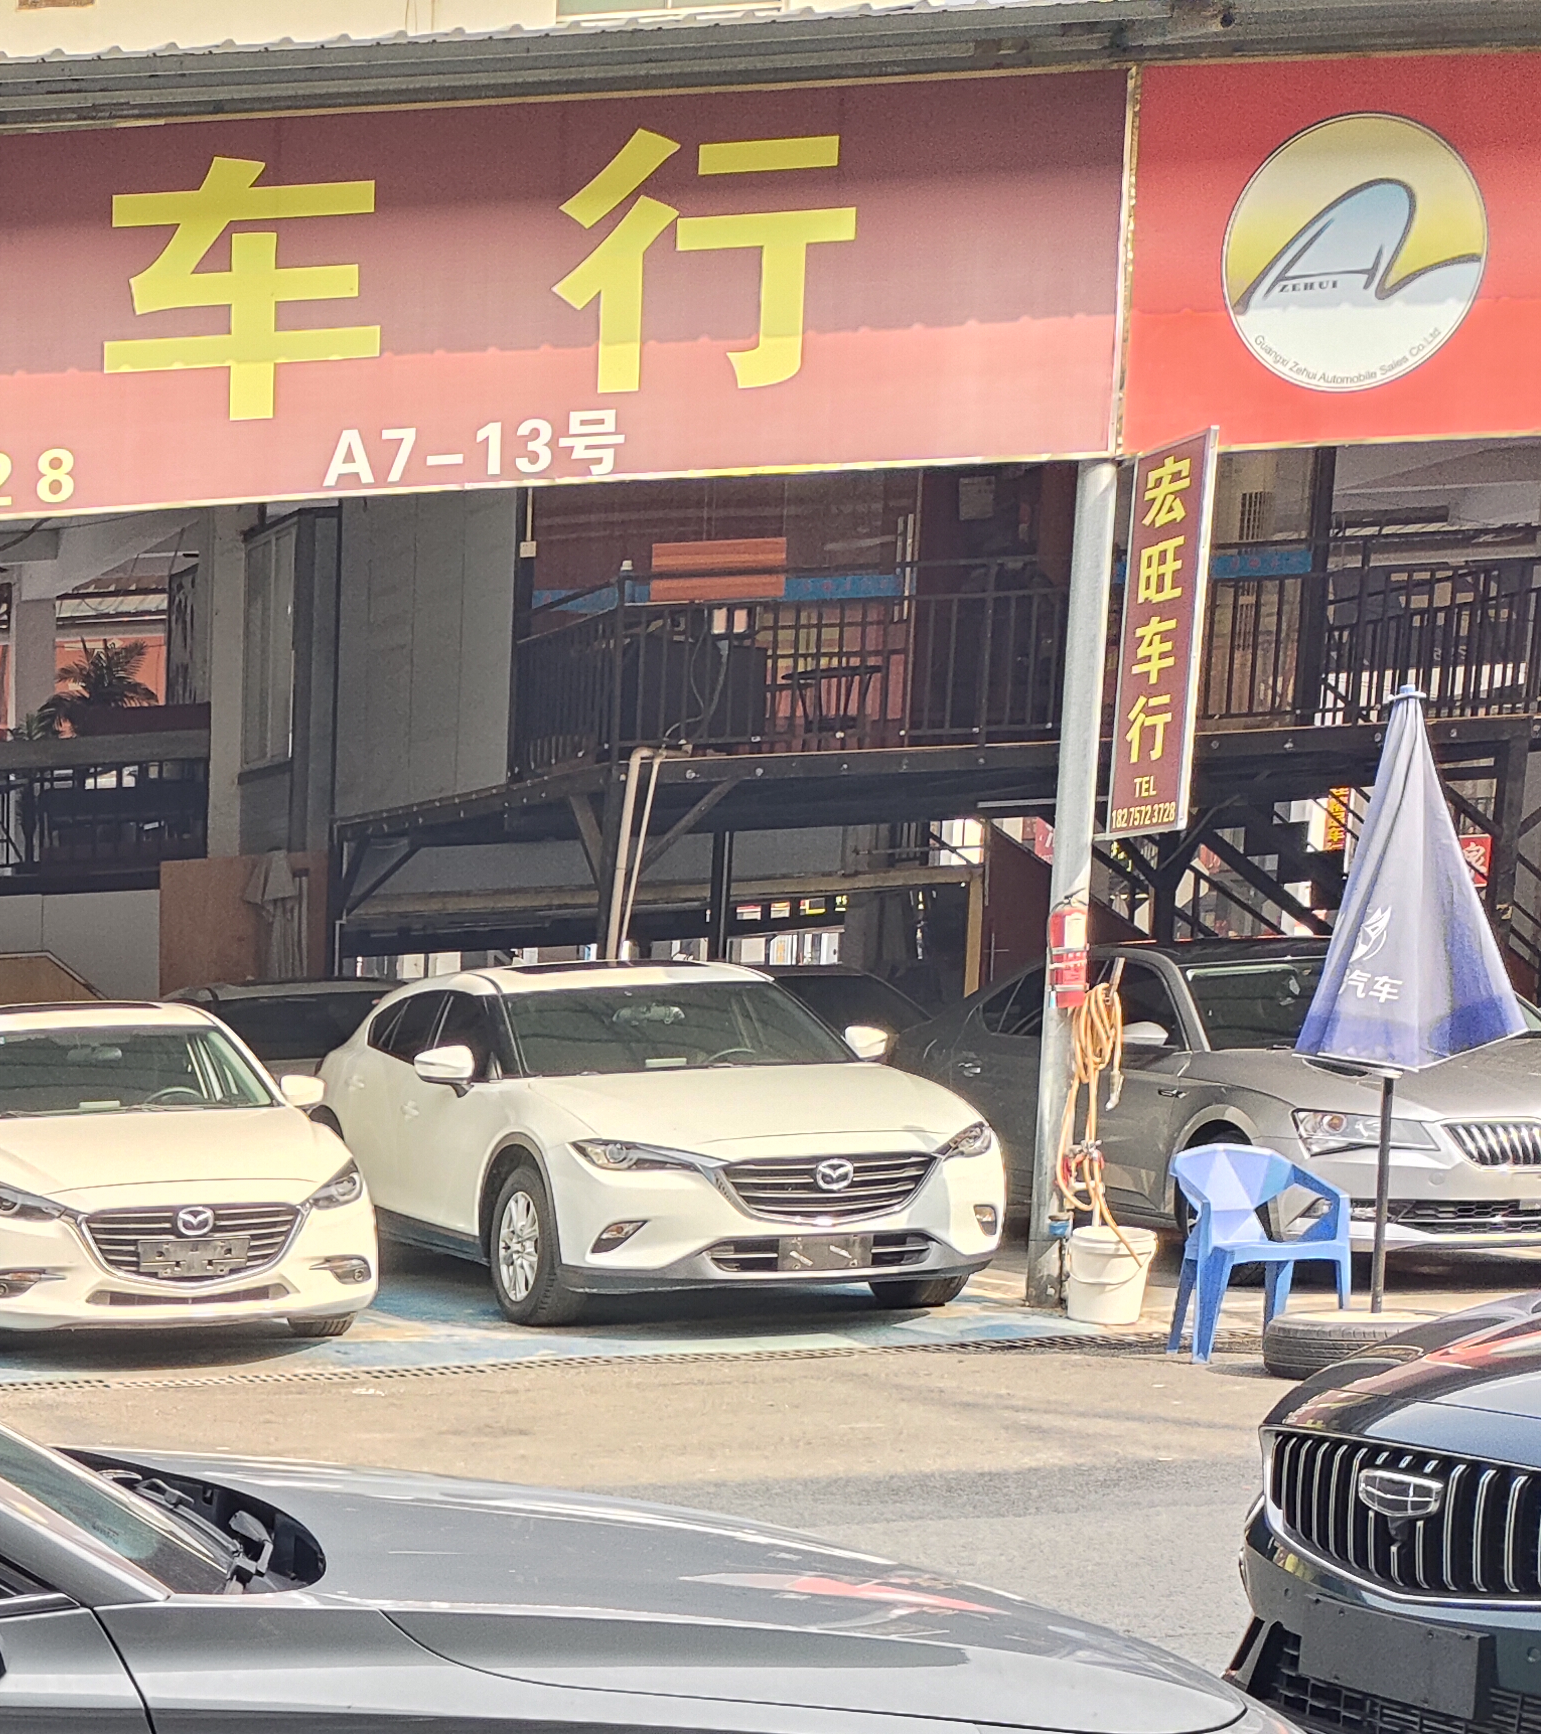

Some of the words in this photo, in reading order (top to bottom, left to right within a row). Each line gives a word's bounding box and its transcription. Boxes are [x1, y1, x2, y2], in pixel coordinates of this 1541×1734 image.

[1278, 280, 1338, 293] ZEHUI
[1254, 334, 1289, 367] Guangxi
[1288, 360, 1317, 380] Zehui
[1318, 371, 1378, 385] Automobile
[1378, 355, 1409, 376] Sales
[323, 408, 626, 488] A7-13号
[1125, 455, 1192, 765] 宏旺车行
[1133, 776, 1157, 798] TEL
